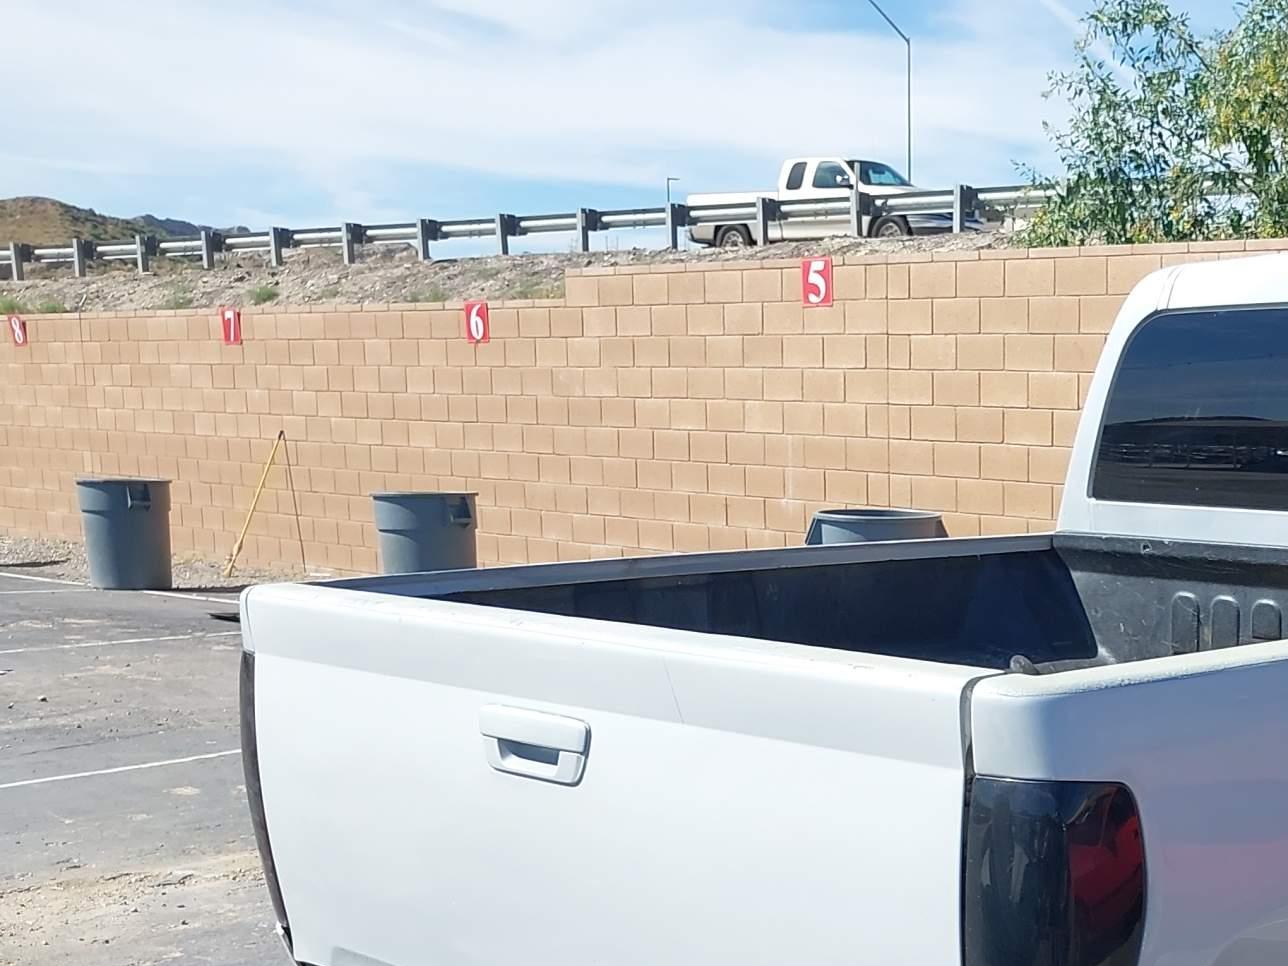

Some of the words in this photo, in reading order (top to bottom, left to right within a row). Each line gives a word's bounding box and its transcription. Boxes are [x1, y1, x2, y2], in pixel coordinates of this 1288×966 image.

[807, 260, 826, 304] 5
[11, 317, 24, 344] 8
[224, 310, 235, 341] 7
[470, 303, 484, 340] 6
